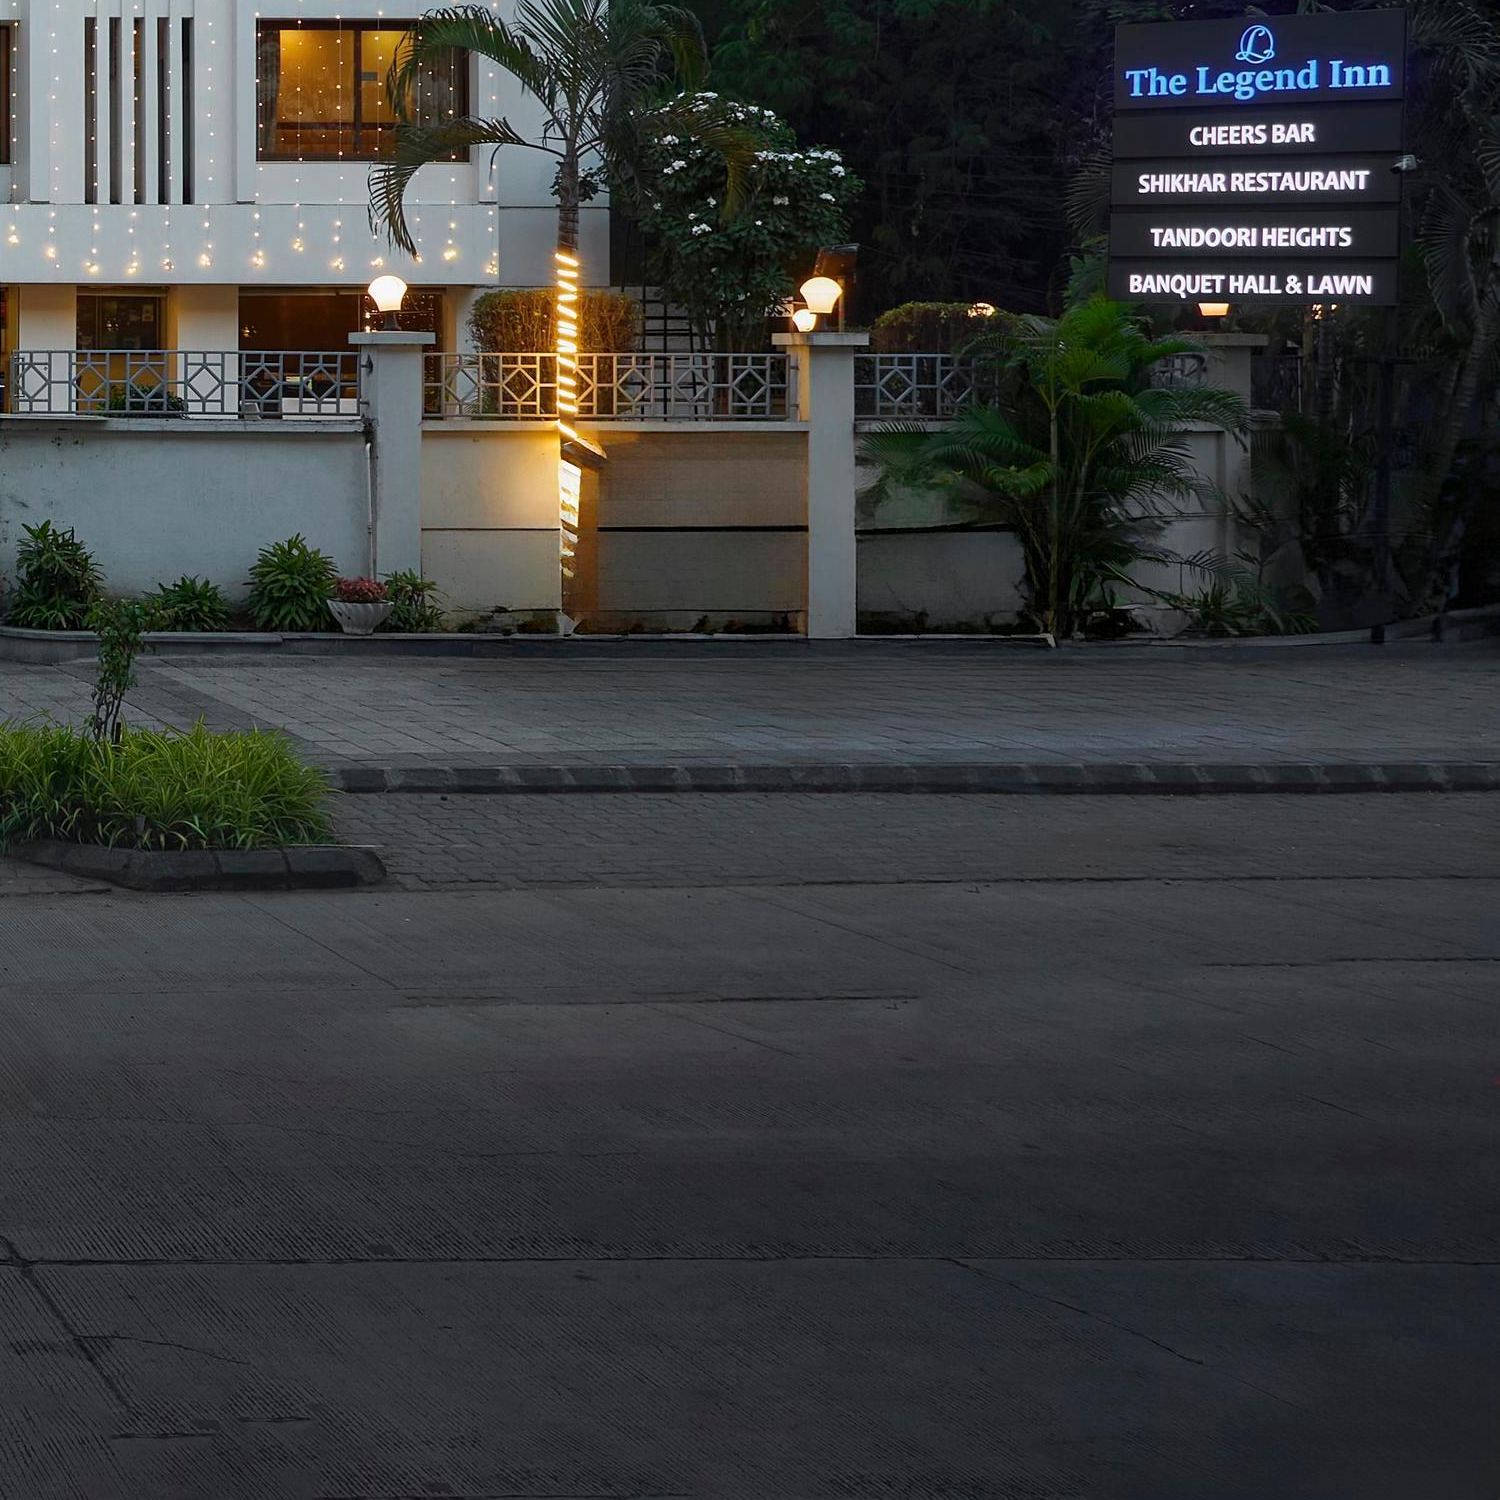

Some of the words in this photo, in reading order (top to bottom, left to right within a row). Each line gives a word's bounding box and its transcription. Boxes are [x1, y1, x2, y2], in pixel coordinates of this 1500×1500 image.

[1126, 68, 1186, 97] The
[1195, 60, 1318, 100] Legend
[1329, 60, 1391, 88] Inn
[1189, 124, 1267, 146] CHEERS
[1272, 123, 1315, 143] BAR
[1138, 173, 1225, 194] SHIKHAR
[1231, 171, 1370, 192] RESTAURANT
[1151, 228, 1257, 247] TANDOORI
[1263, 227, 1352, 247] HEIGHTS
[1129, 275, 1225, 299] BANQUET
[1230, 276, 1282, 294] HALL
[1286, 275, 1302, 294] &
[1308, 276, 1372, 295] LAWN
